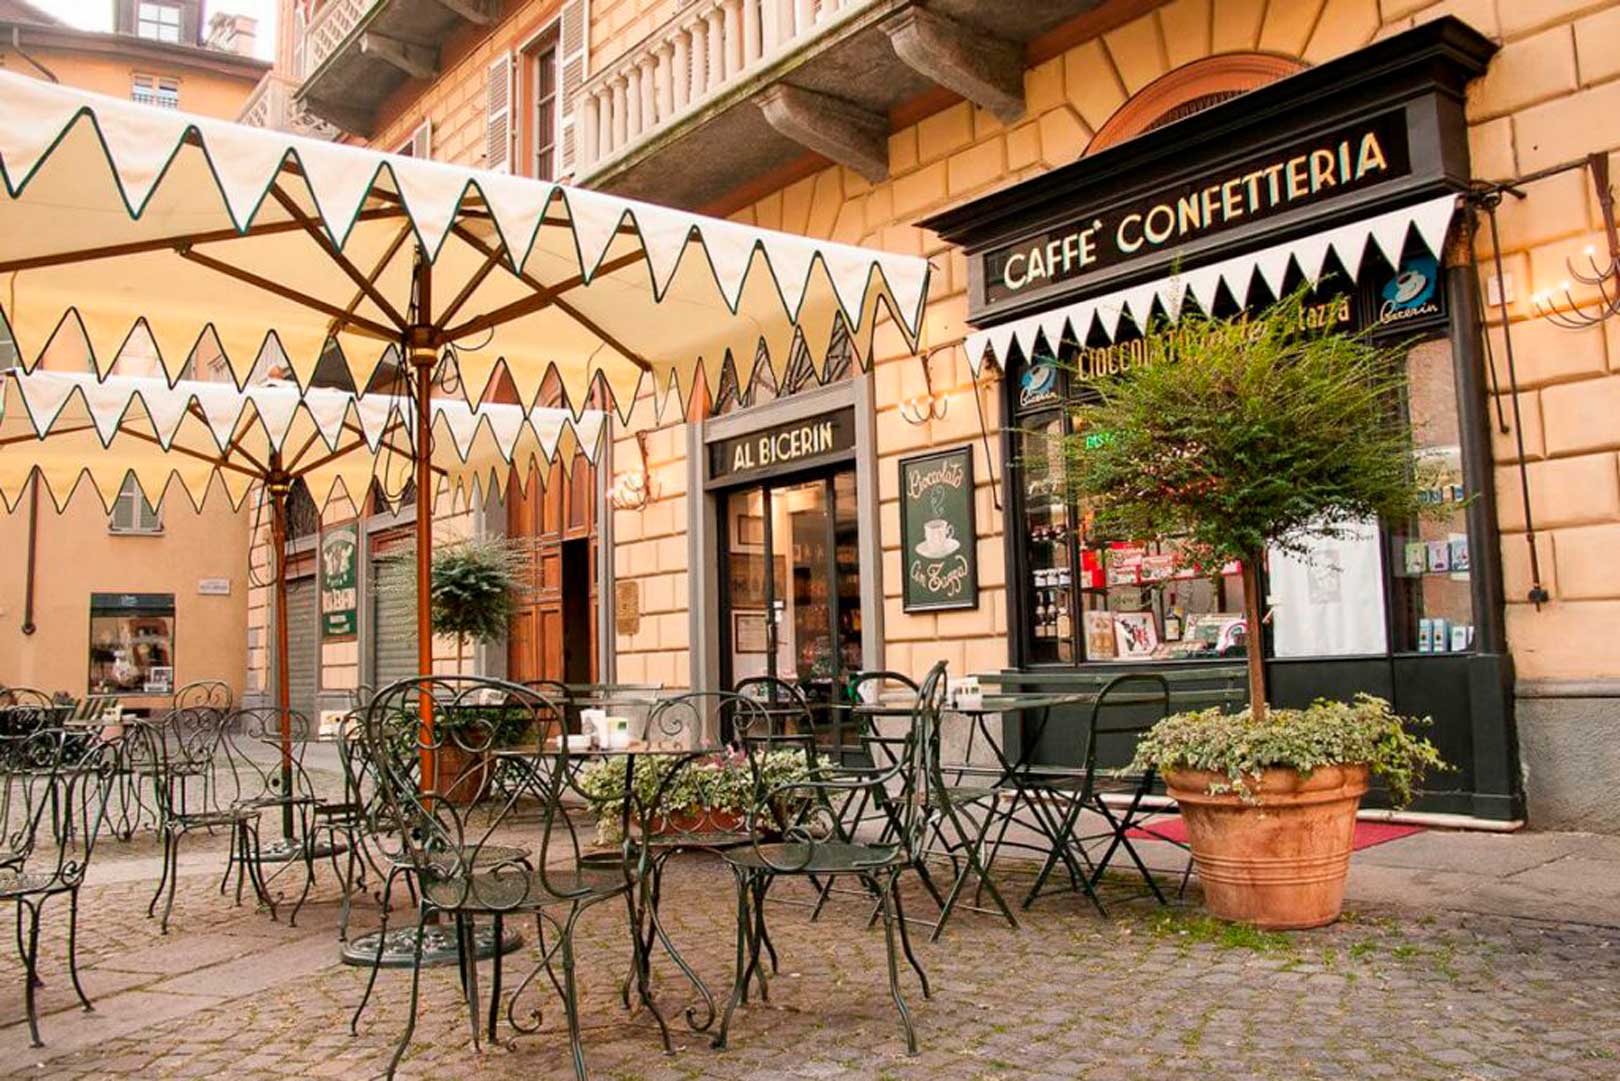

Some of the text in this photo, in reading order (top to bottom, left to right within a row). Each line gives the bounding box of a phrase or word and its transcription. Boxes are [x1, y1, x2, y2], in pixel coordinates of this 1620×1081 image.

[1116, 131, 1388, 253] CONFETTERIA
[733, 421, 833, 472] AL BICERIN
